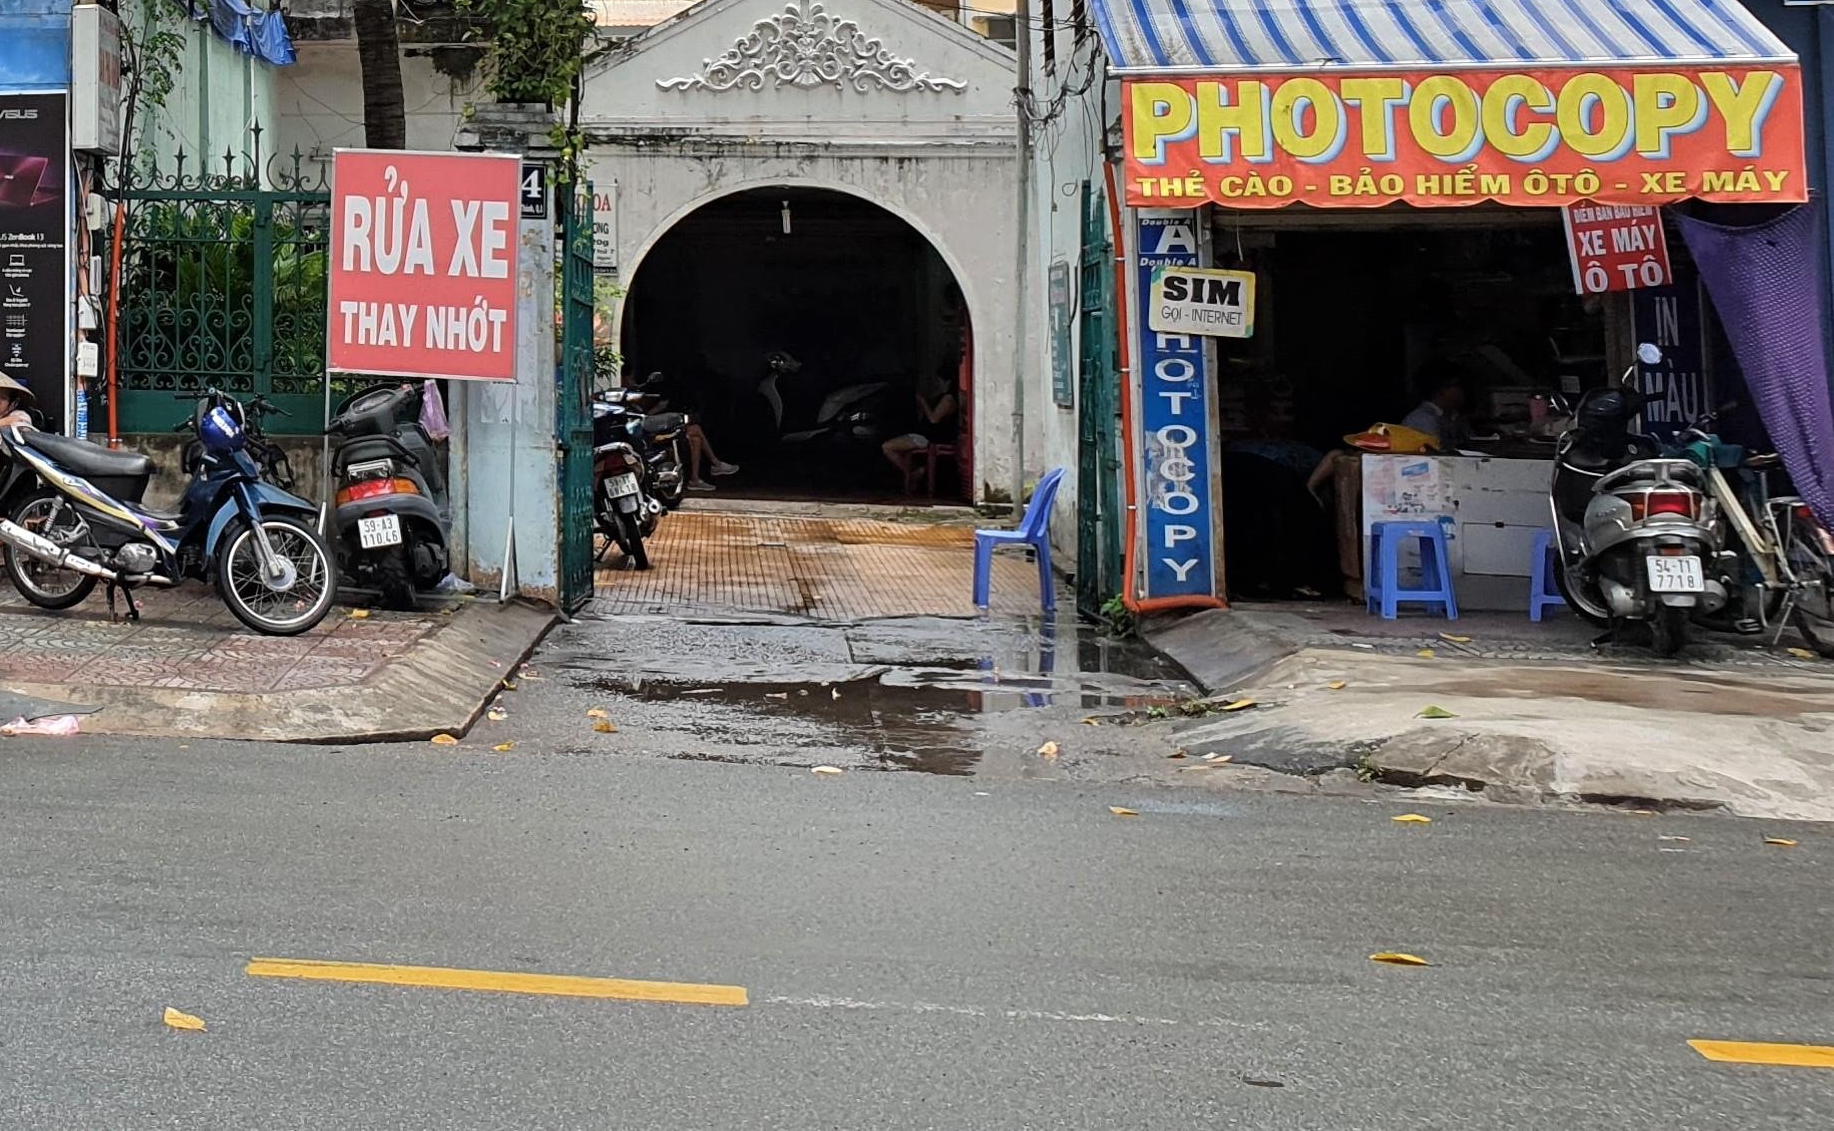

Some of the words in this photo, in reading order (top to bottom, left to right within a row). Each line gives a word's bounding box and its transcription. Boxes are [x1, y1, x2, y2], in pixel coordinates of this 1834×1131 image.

[1131, 71, 1783, 163] PHOTOCOPY
[1220, 170, 1294, 198] CÀO
[1329, 167, 1405, 197] BẢO
[1417, 163, 1511, 198] HIỂM
[1523, 167, 1600, 196] ÔTÔ
[1640, 171, 1686, 194] XE
[1703, 163, 1789, 193] MÁY
[342, 164, 435, 275] RỬA
[448, 199, 510, 279] XE
[1577, 230, 1606, 257] XE
[1611, 219, 1655, 253] MÁY
[1140, 258, 1184, 266] Double
[1585, 260, 1608, 293] Ô
[1617, 254, 1663, 289] TÔ
[1163, 276, 1241, 307] SIM
[340, 300, 418, 347] THAY
[426, 295, 507, 353] NHỚT
[1191, 309, 1243, 325] INTERNET
[1154, 332, 1198, 581] HOTOCOPY
[1657, 575, 1694, 588] 7718
